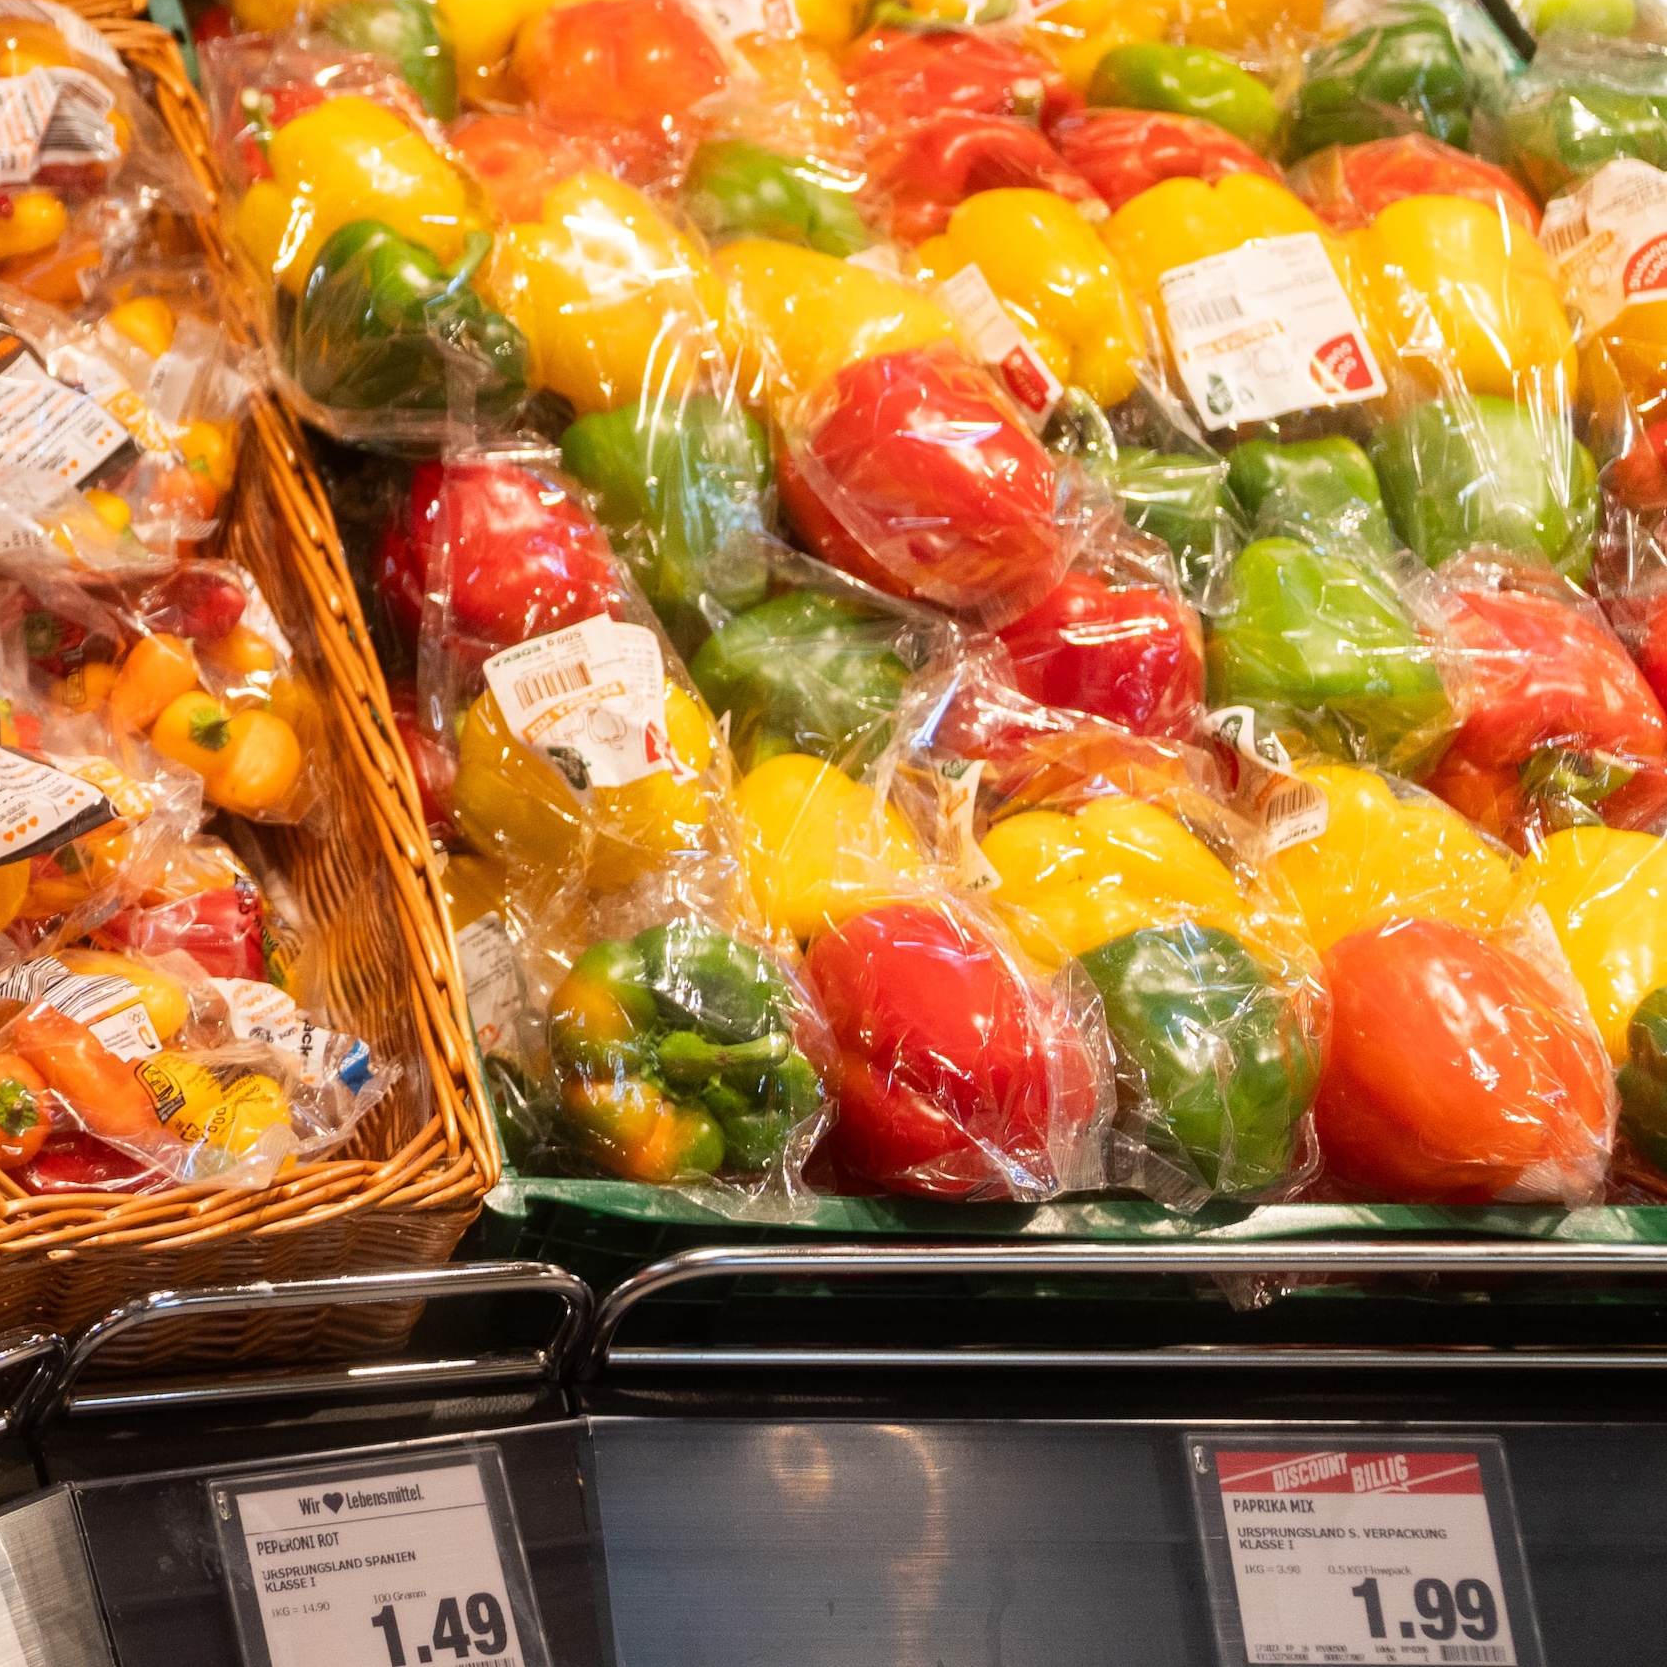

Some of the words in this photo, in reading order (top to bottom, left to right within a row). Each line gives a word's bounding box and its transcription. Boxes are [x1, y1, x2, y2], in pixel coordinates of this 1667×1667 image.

[491, 644, 542, 669] EDEKA
[1271, 1451, 1349, 1493] DISCOUNT
[1350, 1454, 1410, 1494] BILLIG
[297, 1496, 322, 1517] Wir
[345, 1483, 426, 1511] Lebensmittel.
[1232, 1498, 1288, 1514] PAPRIKA
[1289, 1499, 1316, 1514] MIX
[255, 1534, 317, 1557] PEPERONI
[316, 1531, 341, 1550] ROT
[1237, 1526, 1346, 1540] URSPRUNGSLAND
[1363, 1527, 1448, 1540] VERPACKUNG
[1239, 1539, 1286, 1551] KLASSE
[261, 1557, 364, 1582] URSPRUNGSLAND
[364, 1549, 417, 1569] SPANIEN
[1244, 1564, 1266, 1575] 1KG
[1276, 1564, 1302, 1575] 3.98
[264, 1578, 308, 1594] KLASSE
[372, 1592, 392, 1605] 100
[393, 1588, 428, 1604] Gramm
[270, 1605, 291, 1619] 1KG
[301, 1600, 331, 1615] 14.90
[1351, 1577, 1499, 1642] 1.99
[370, 1591, 508, 1667] 1.49
